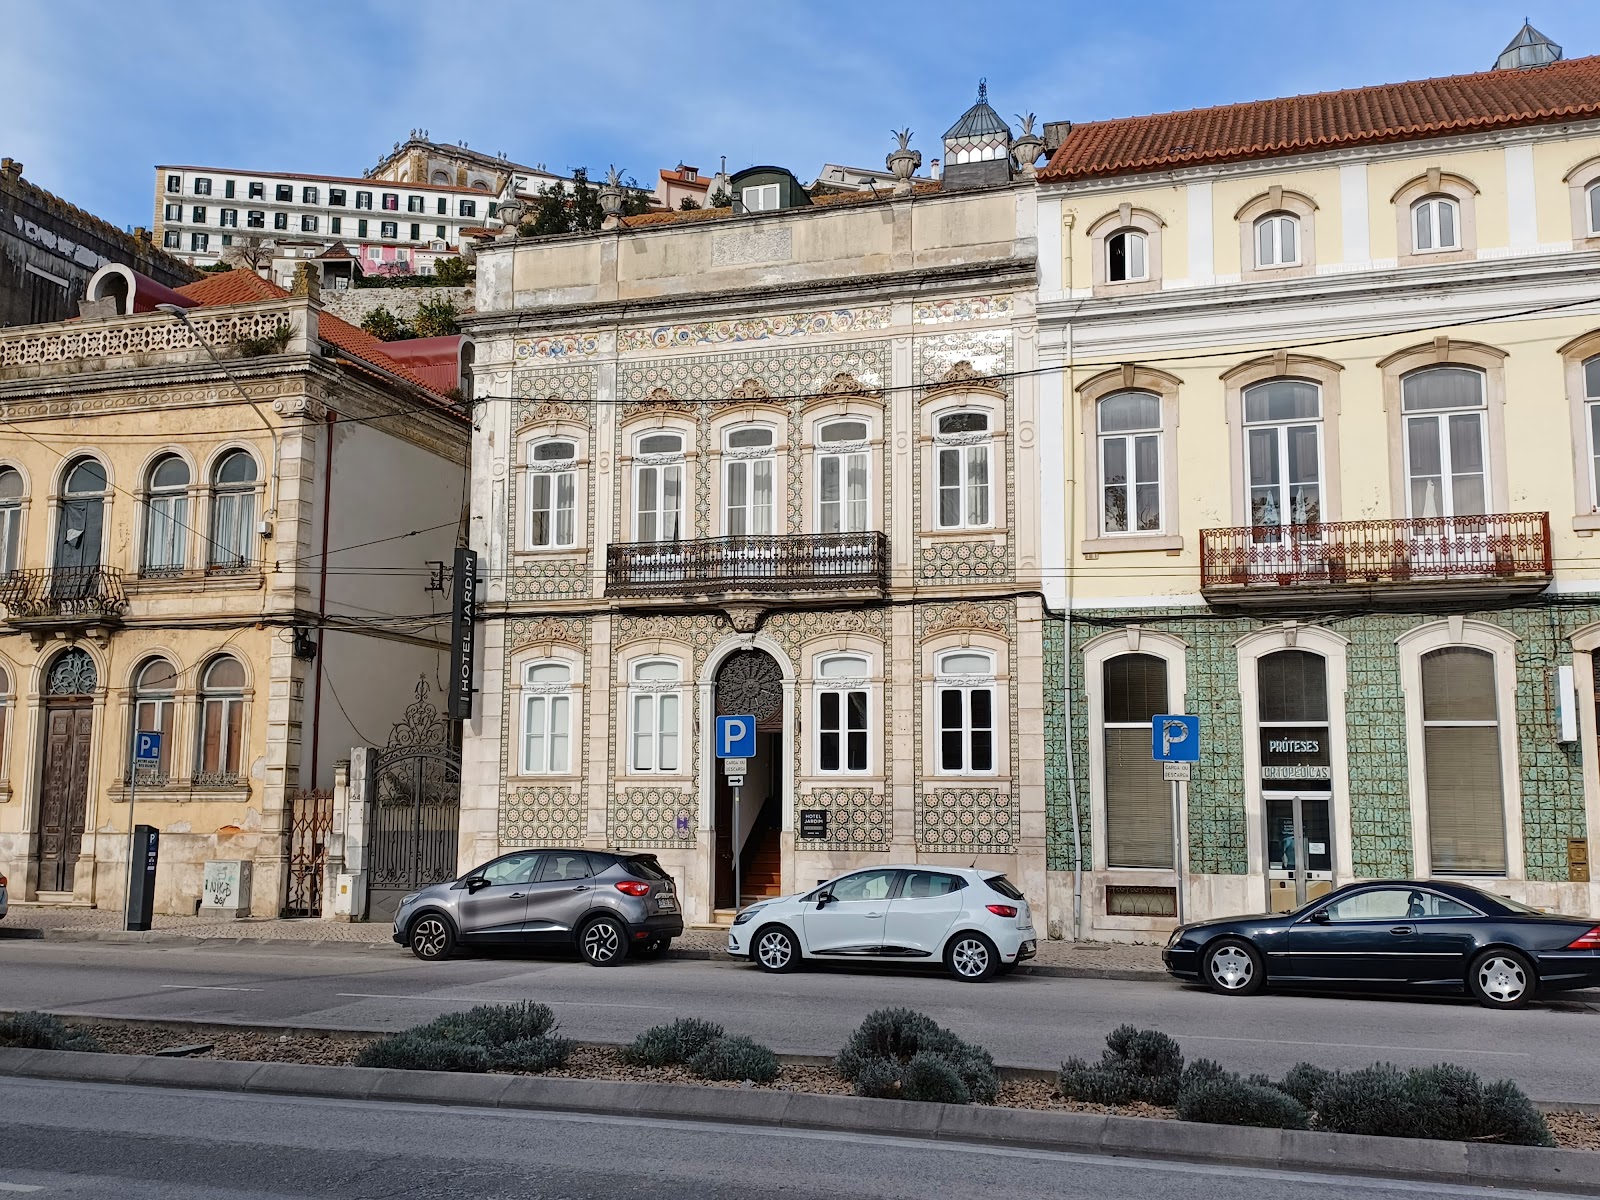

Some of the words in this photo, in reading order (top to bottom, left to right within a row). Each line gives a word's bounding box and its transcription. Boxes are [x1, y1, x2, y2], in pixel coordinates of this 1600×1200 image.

[463, 557, 474, 626] JARDIM
[462, 631, 471, 692] HOTEL
[140, 736, 151, 756] P
[724, 719, 747, 754] P
[1162, 719, 1189, 757] P
[1269, 736, 1320, 753] PRÓTESES
